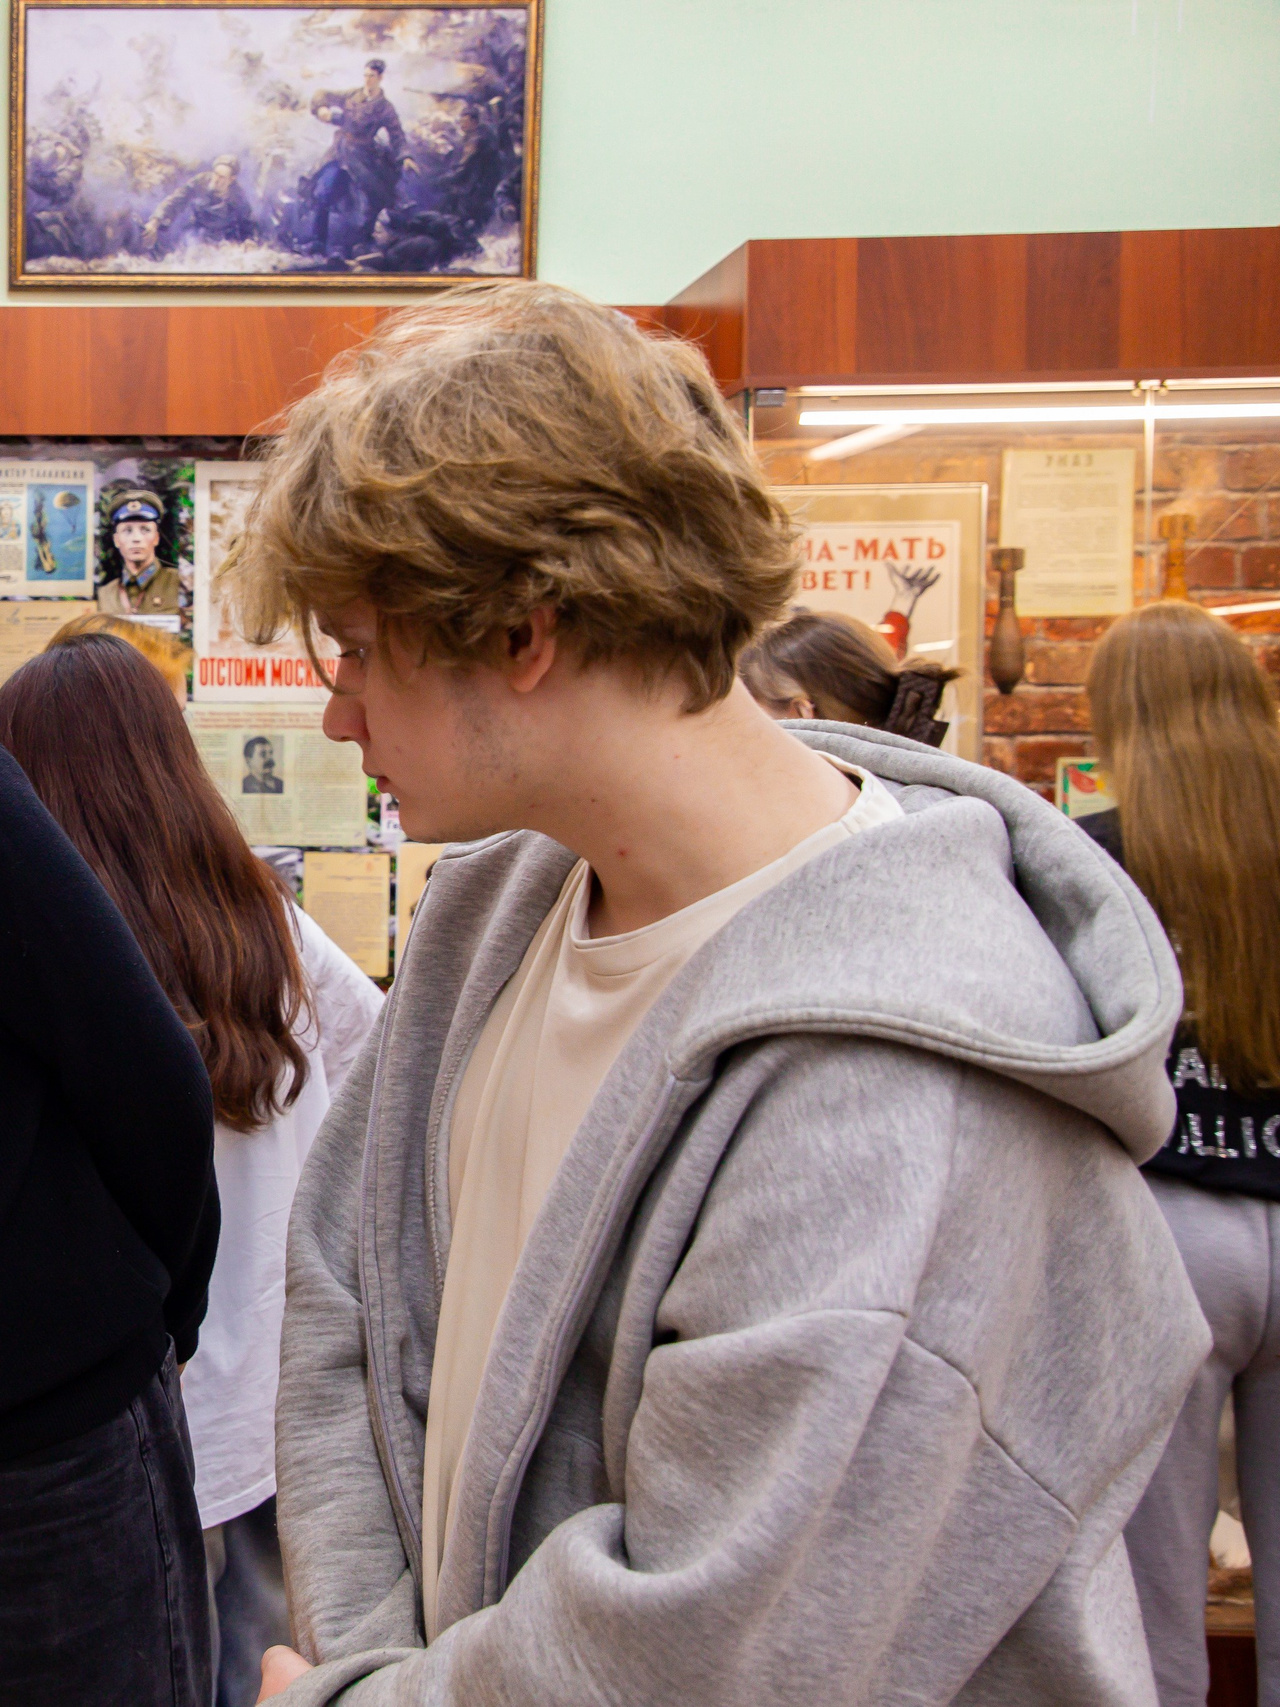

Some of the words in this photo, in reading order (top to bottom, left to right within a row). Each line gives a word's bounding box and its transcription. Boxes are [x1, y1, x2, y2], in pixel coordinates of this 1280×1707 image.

[799, 537, 946, 561] НА-МАТЬ
[801, 570, 871, 591] ВЕТ!
[199, 657, 267, 687] ОТСТОИМ
[270, 657, 341, 687] МОСКВУ
